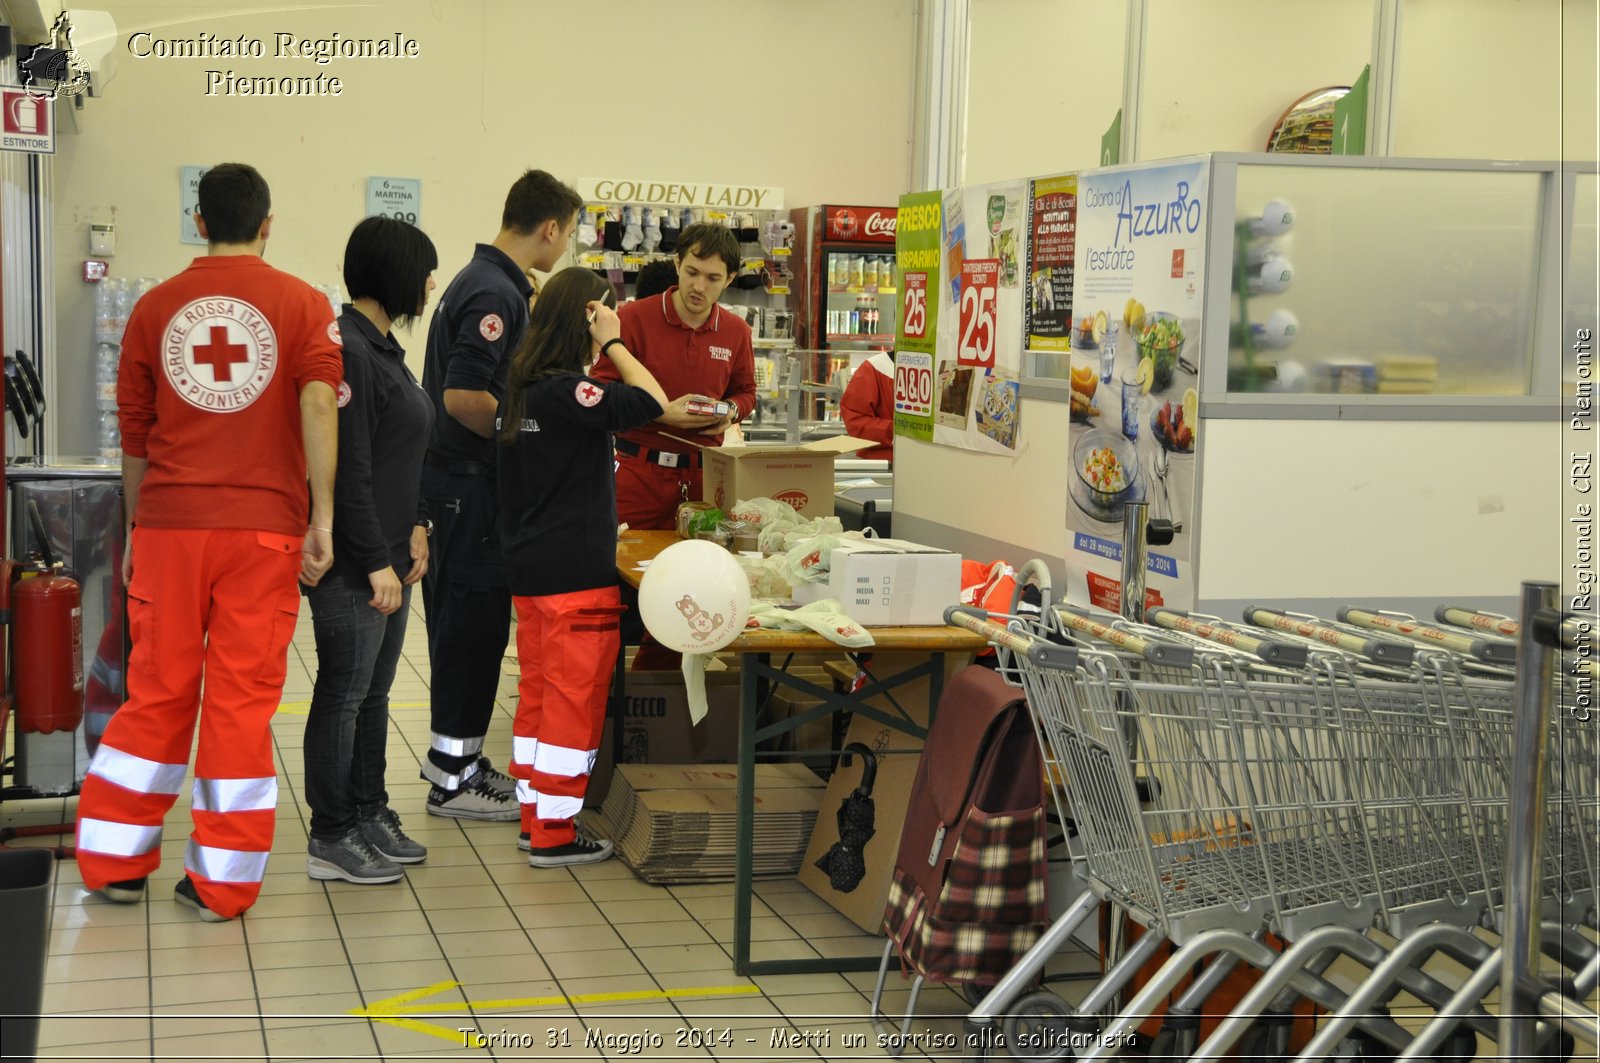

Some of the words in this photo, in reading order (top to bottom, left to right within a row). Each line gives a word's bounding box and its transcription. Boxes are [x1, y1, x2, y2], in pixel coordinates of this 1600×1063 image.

[3, 137, 49, 148] ESTINTORE
[375, 190, 413, 200] MARTINA
[383, 180, 390, 189] 6
[594, 180, 697, 205] GOLDEN
[704, 186, 769, 208] LADY
[1086, 188, 1113, 208] Colora
[897, 203, 941, 232] FRESCO
[897, 249, 940, 269] RISPARMIO
[1085, 245, 1135, 271] l'estate
[168, 325, 187, 377] CROCE
[184, 302, 235, 323] ROSSA
[239, 309, 273, 372] ITALIANA
[186, 383, 259, 407] PIONIERI
[896, 368, 931, 403] A&O
[1080, 537, 1088, 548] dal
[1089, 540, 1097, 551] 28
[1098, 544, 1117, 558] maggio
[1156, 558, 1171, 572] 2014
[856, 598, 870, 606] MAXI
